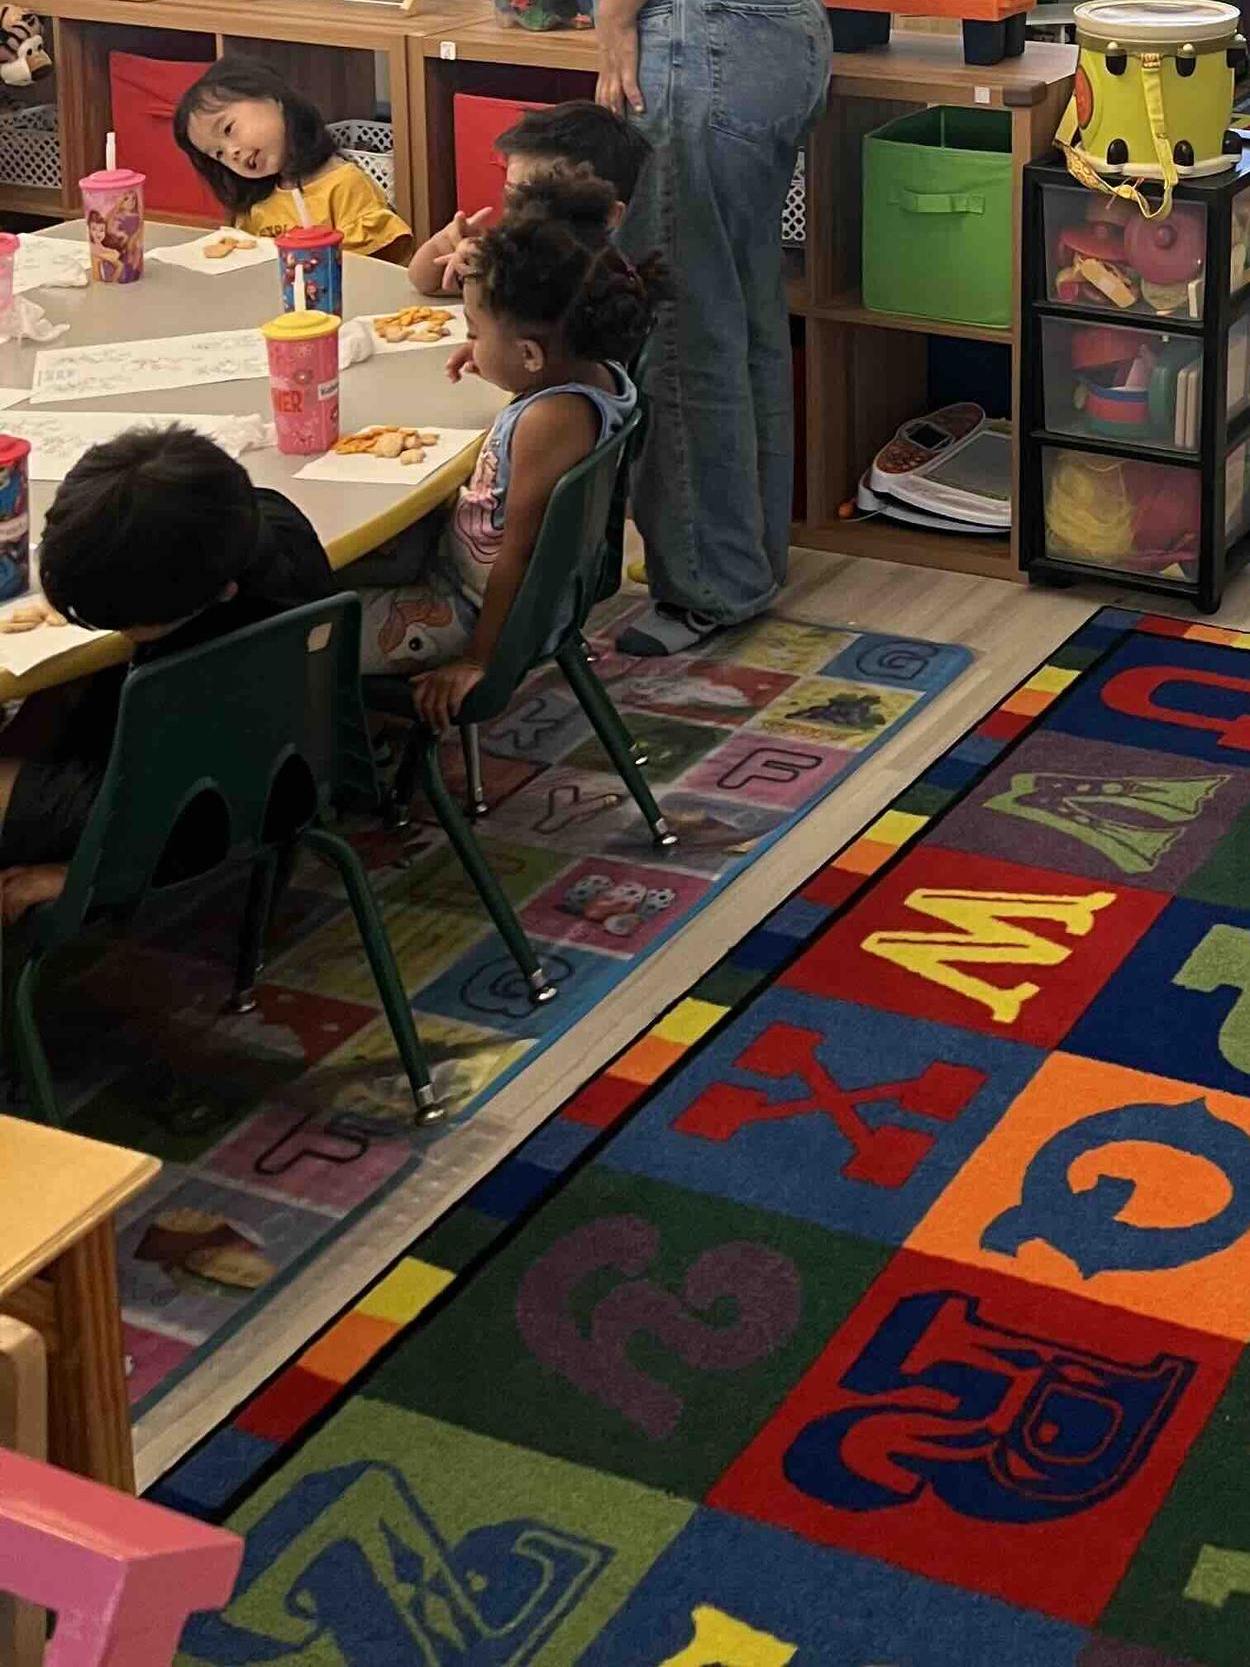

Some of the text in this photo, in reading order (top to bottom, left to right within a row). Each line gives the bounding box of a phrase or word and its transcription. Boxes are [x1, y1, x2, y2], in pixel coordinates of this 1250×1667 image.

[716, 747, 823, 790] F
[672, 1024, 987, 1188] X
[783, 1289, 1194, 1524] R
